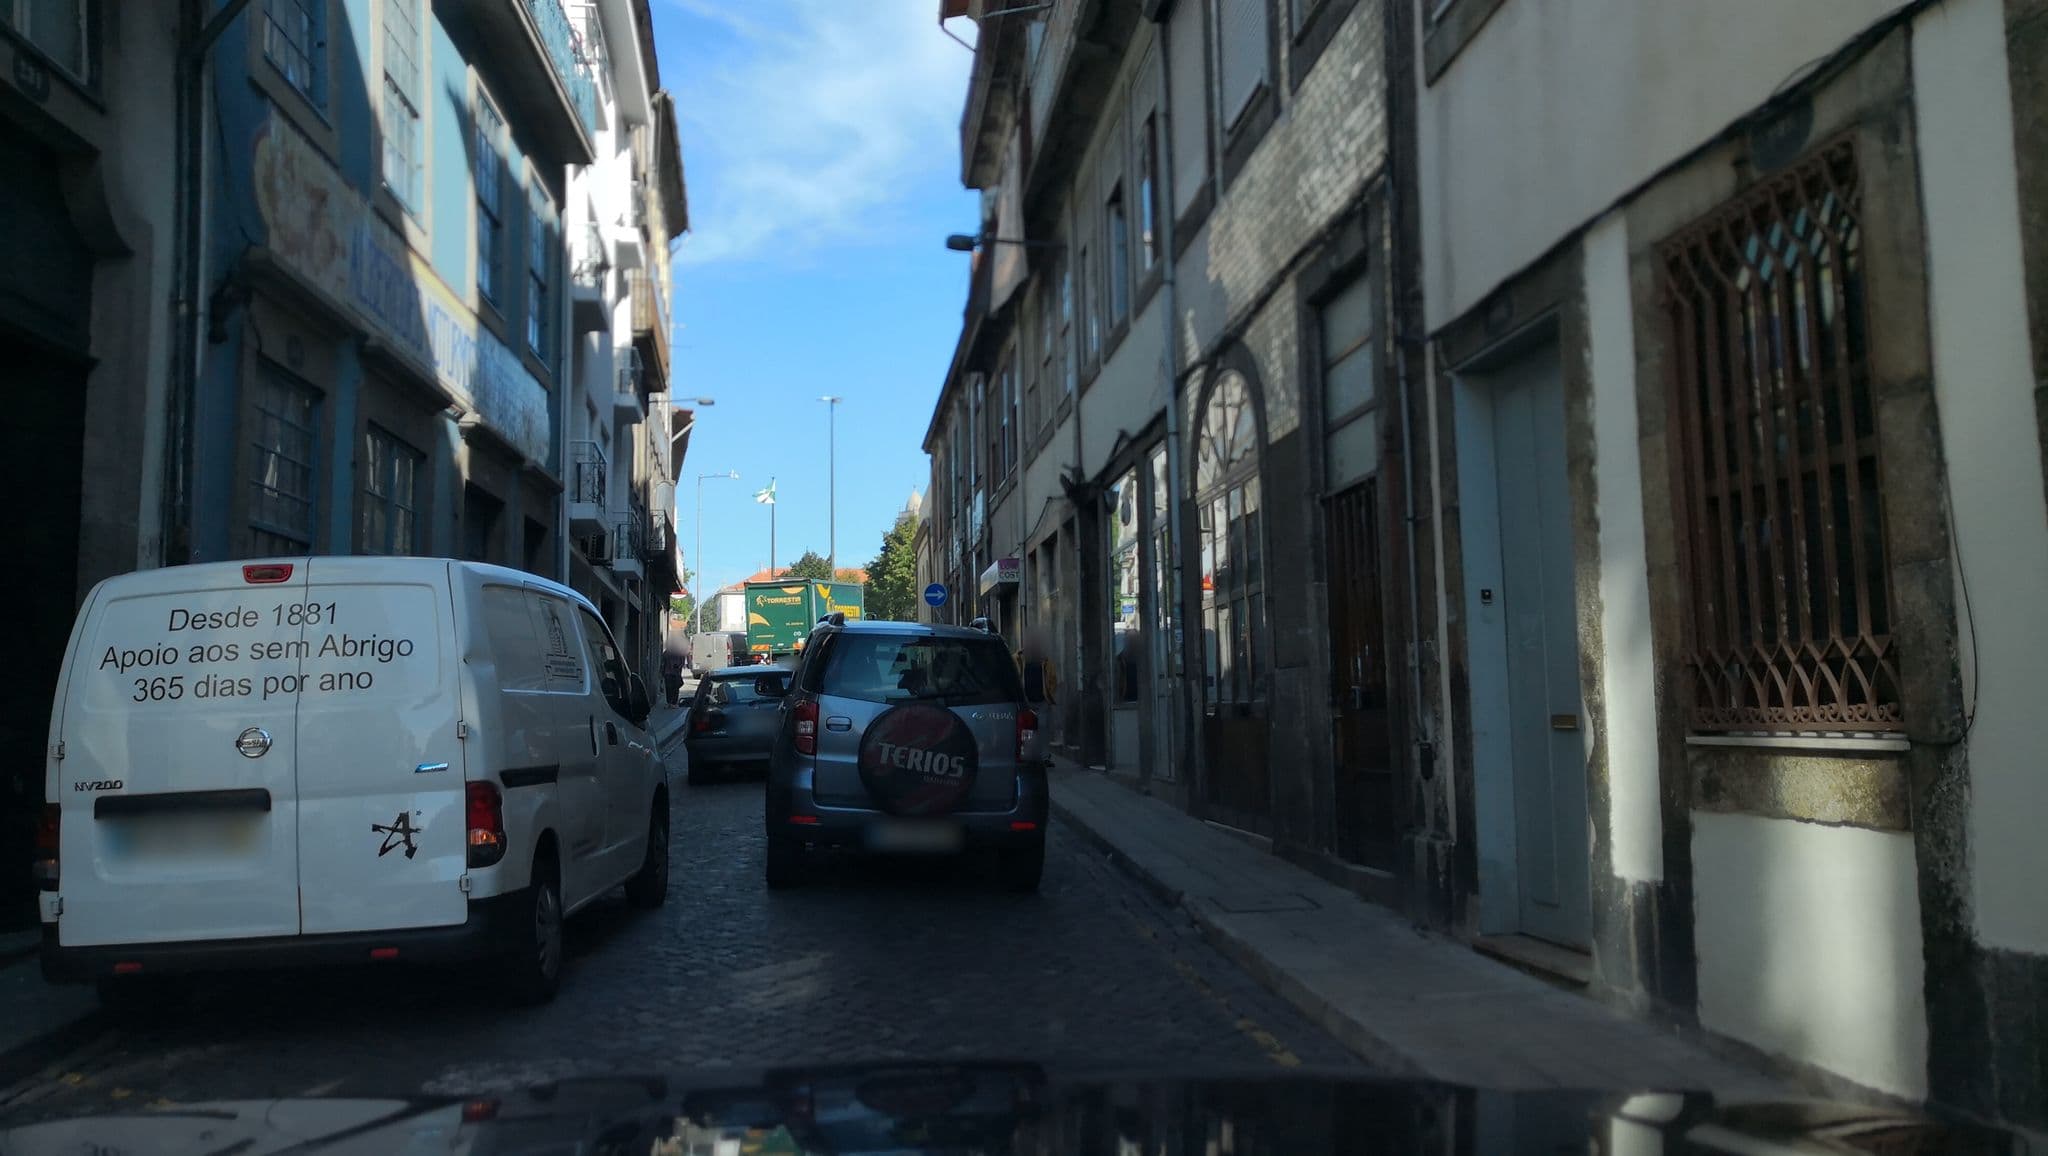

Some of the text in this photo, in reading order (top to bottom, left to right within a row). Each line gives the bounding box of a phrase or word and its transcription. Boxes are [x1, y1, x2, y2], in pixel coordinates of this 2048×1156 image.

[168, 602, 337, 632] Desde 1881
[99, 633, 414, 674] Apoio aos sem Abrigo
[133, 670, 373, 702] 365 dias por ano
[878, 742, 965, 777] TERIOS
[74, 779, 123, 792] NV200
